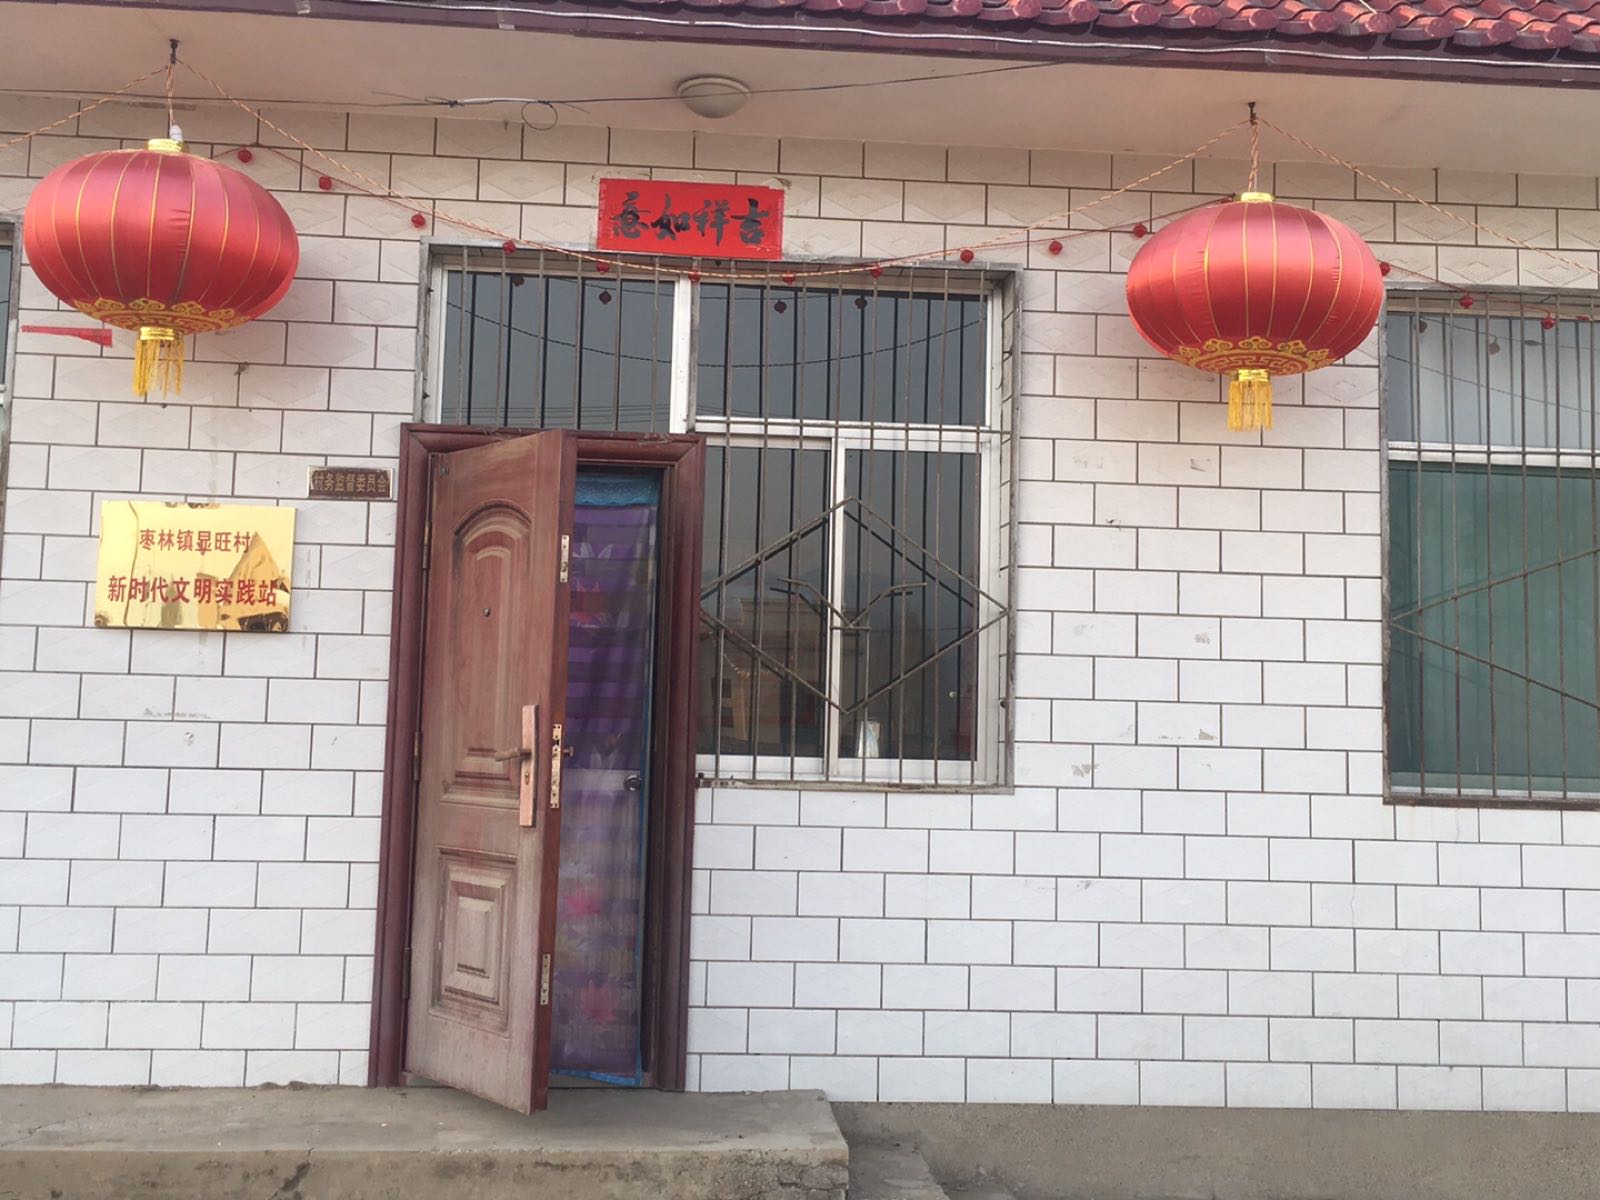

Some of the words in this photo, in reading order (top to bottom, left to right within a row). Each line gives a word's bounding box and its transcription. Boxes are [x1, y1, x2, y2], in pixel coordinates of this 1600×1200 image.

[139, 528, 251, 554] 枣林镇显旺村
[107, 575, 278, 606] 新时代文明实践站
